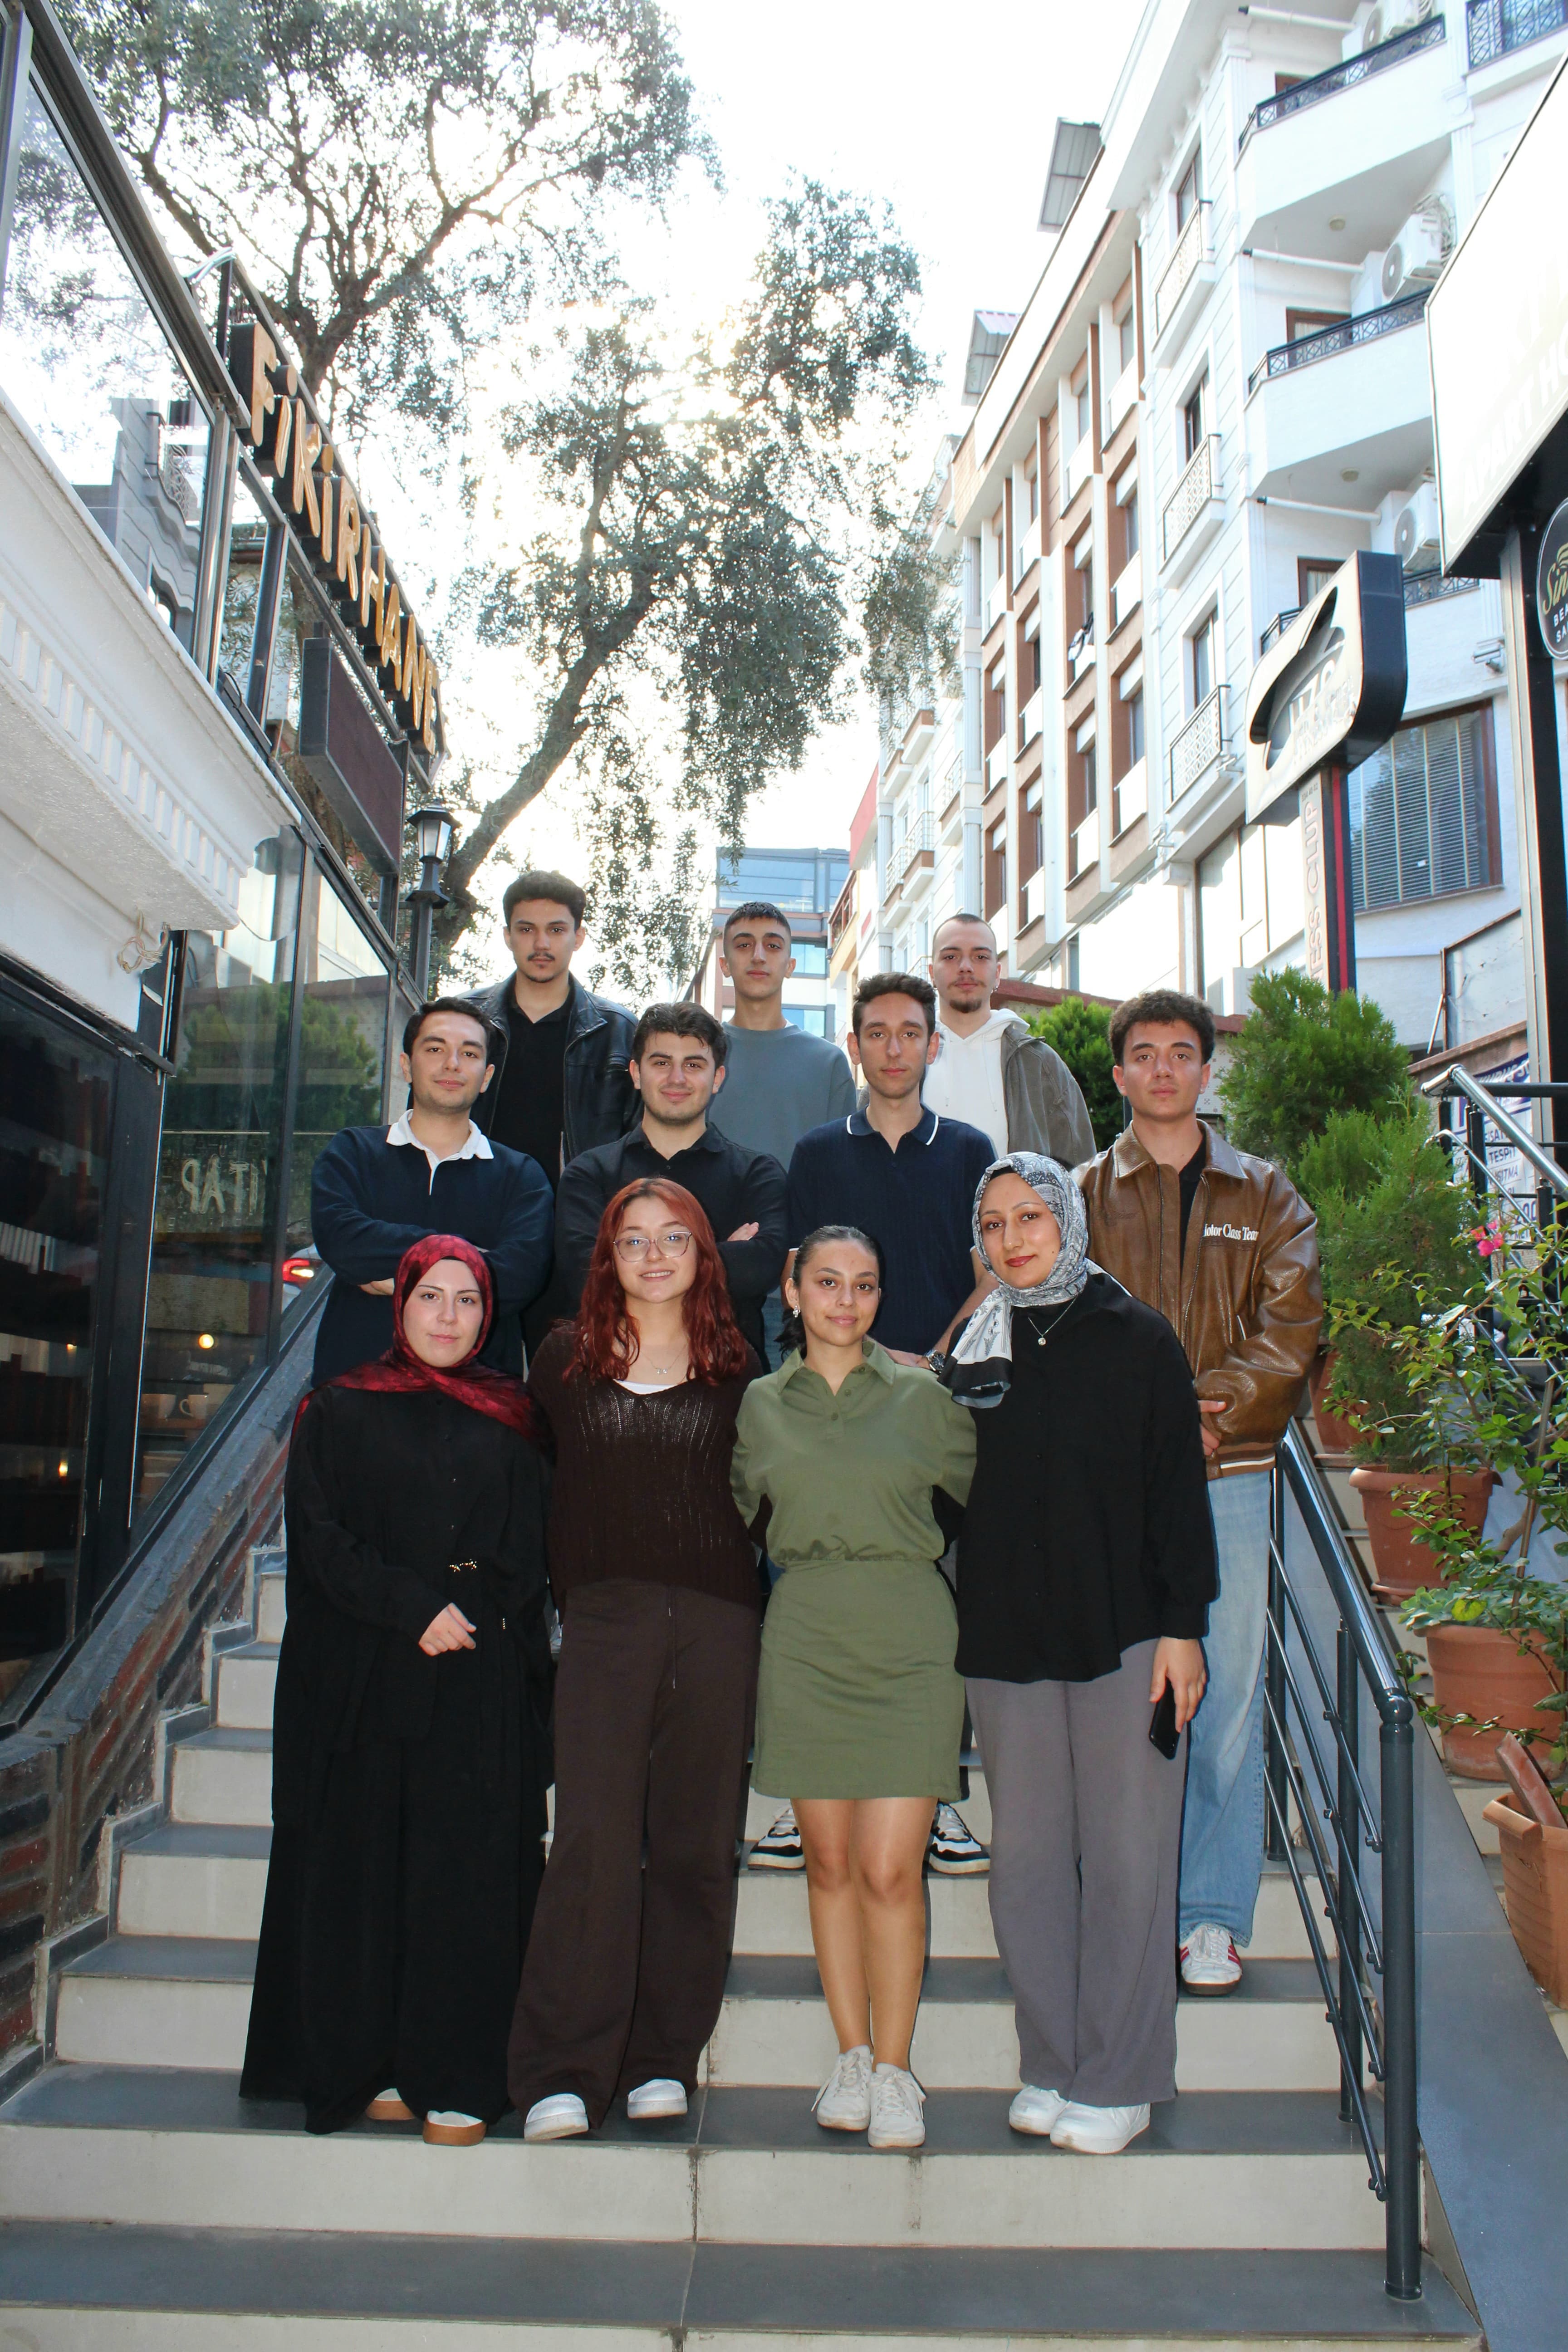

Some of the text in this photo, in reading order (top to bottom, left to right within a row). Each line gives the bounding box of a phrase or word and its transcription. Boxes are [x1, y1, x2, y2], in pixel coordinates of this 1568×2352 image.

[1556, 621, 1568, 643] SA
[1304, 801, 1320, 894] CLUP
[1222, 1224, 1242, 1240] Class
